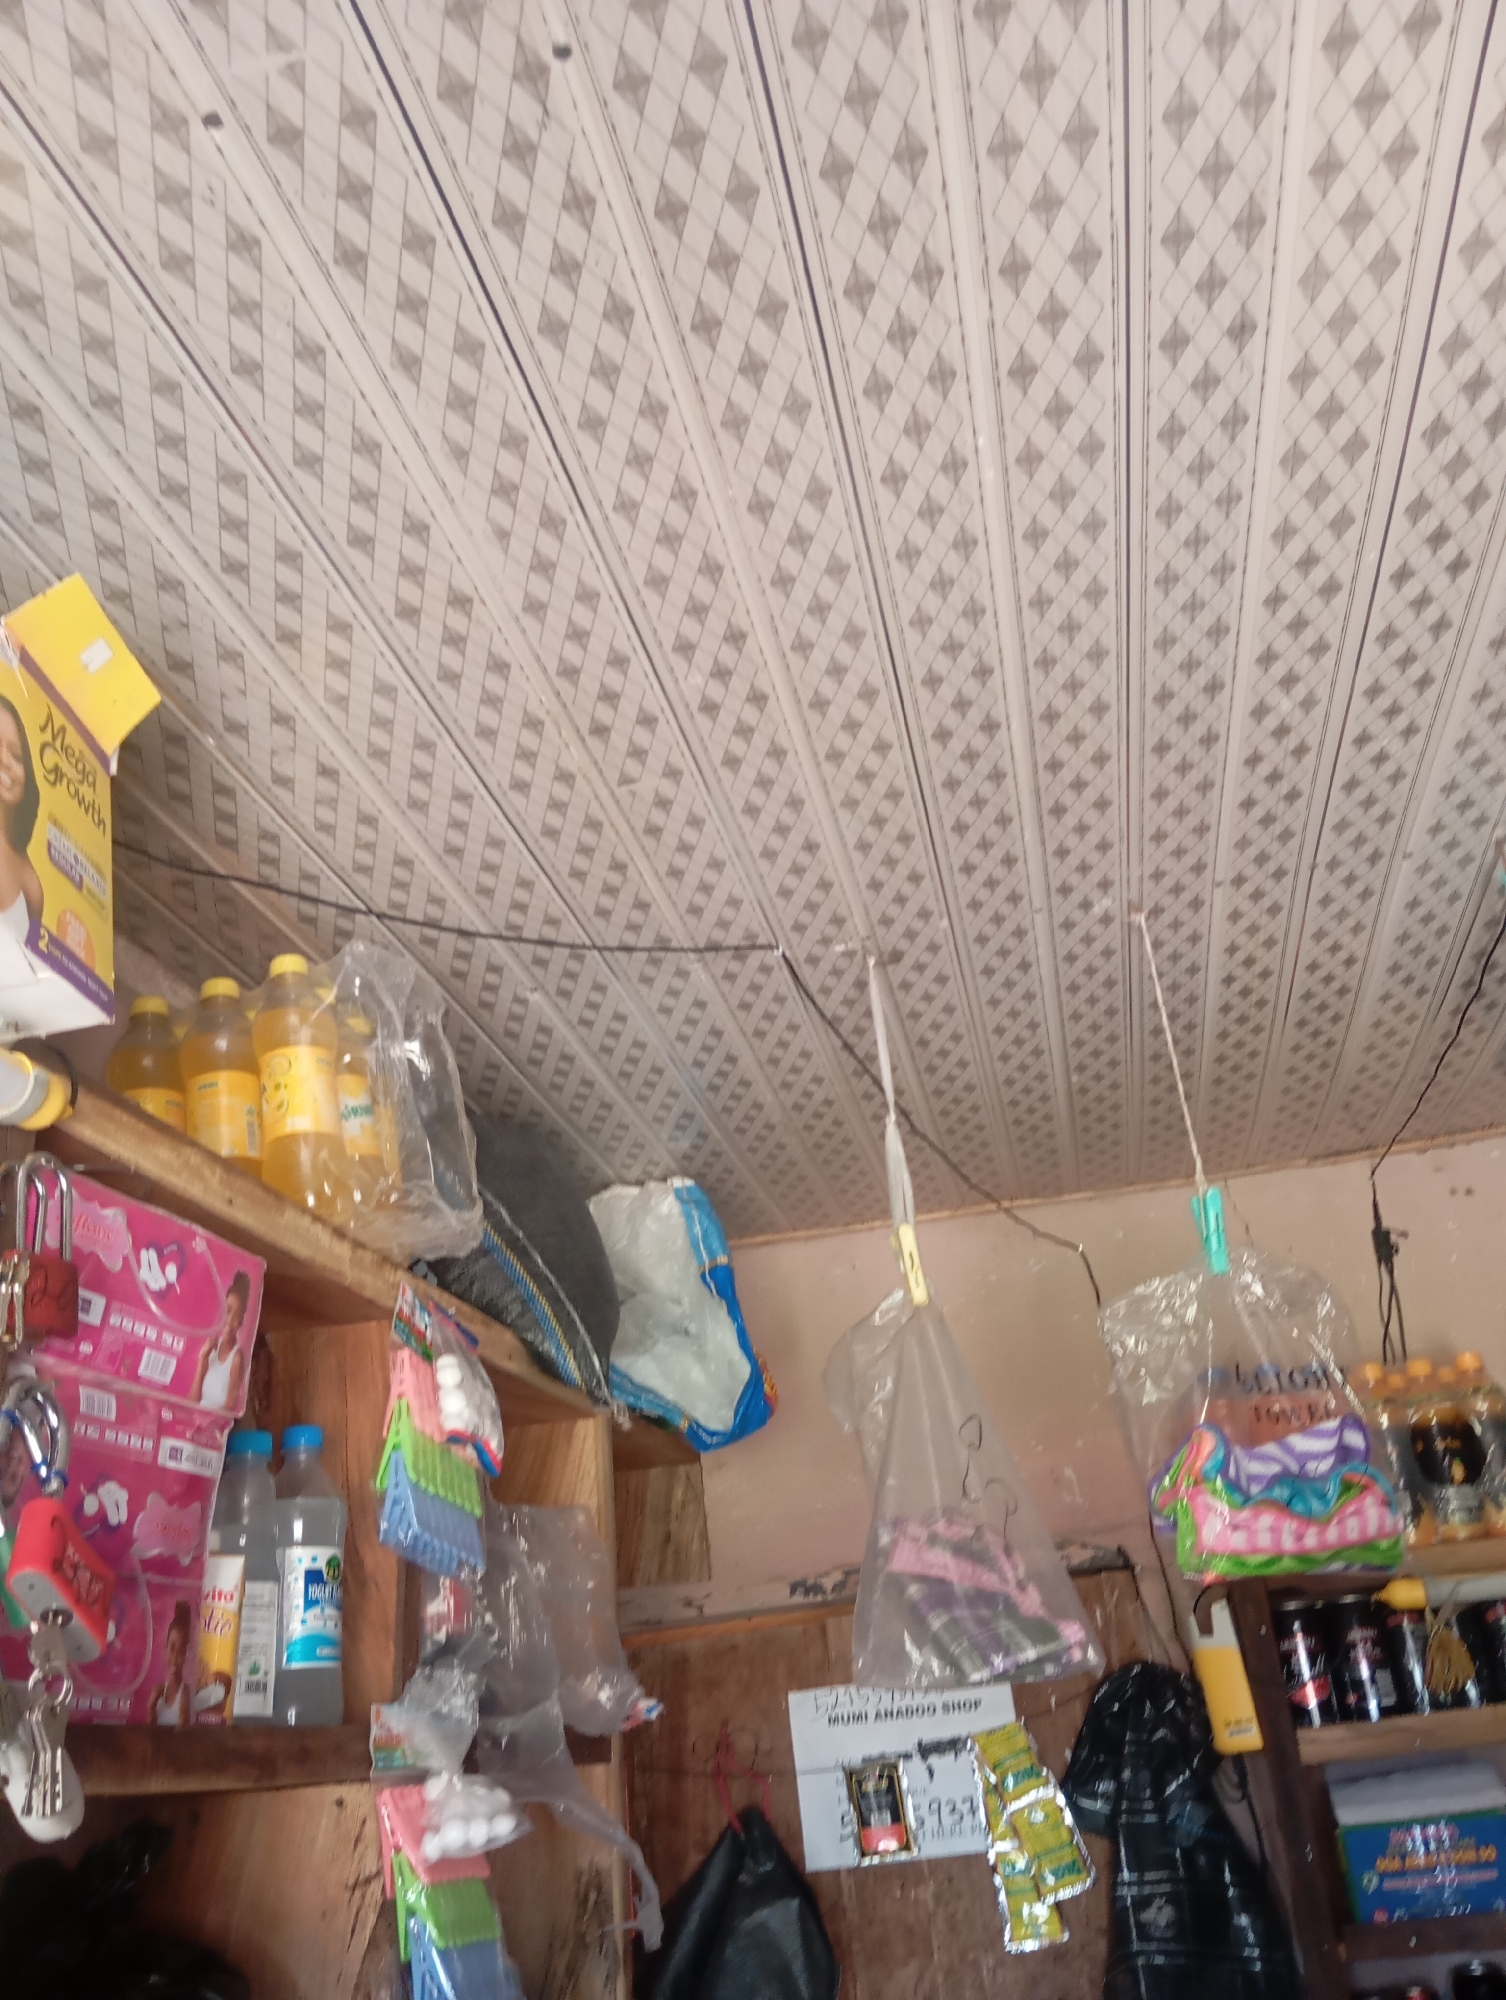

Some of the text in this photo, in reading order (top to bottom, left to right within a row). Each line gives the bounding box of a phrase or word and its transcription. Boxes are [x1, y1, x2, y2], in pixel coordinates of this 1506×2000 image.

[39, 702, 97, 793] Mega
[39, 740, 107, 838] Growth
[38, 926, 49, 954] 2
[828, 1709, 868, 1728] MUMI
[941, 1697, 982, 1717] SHOP
